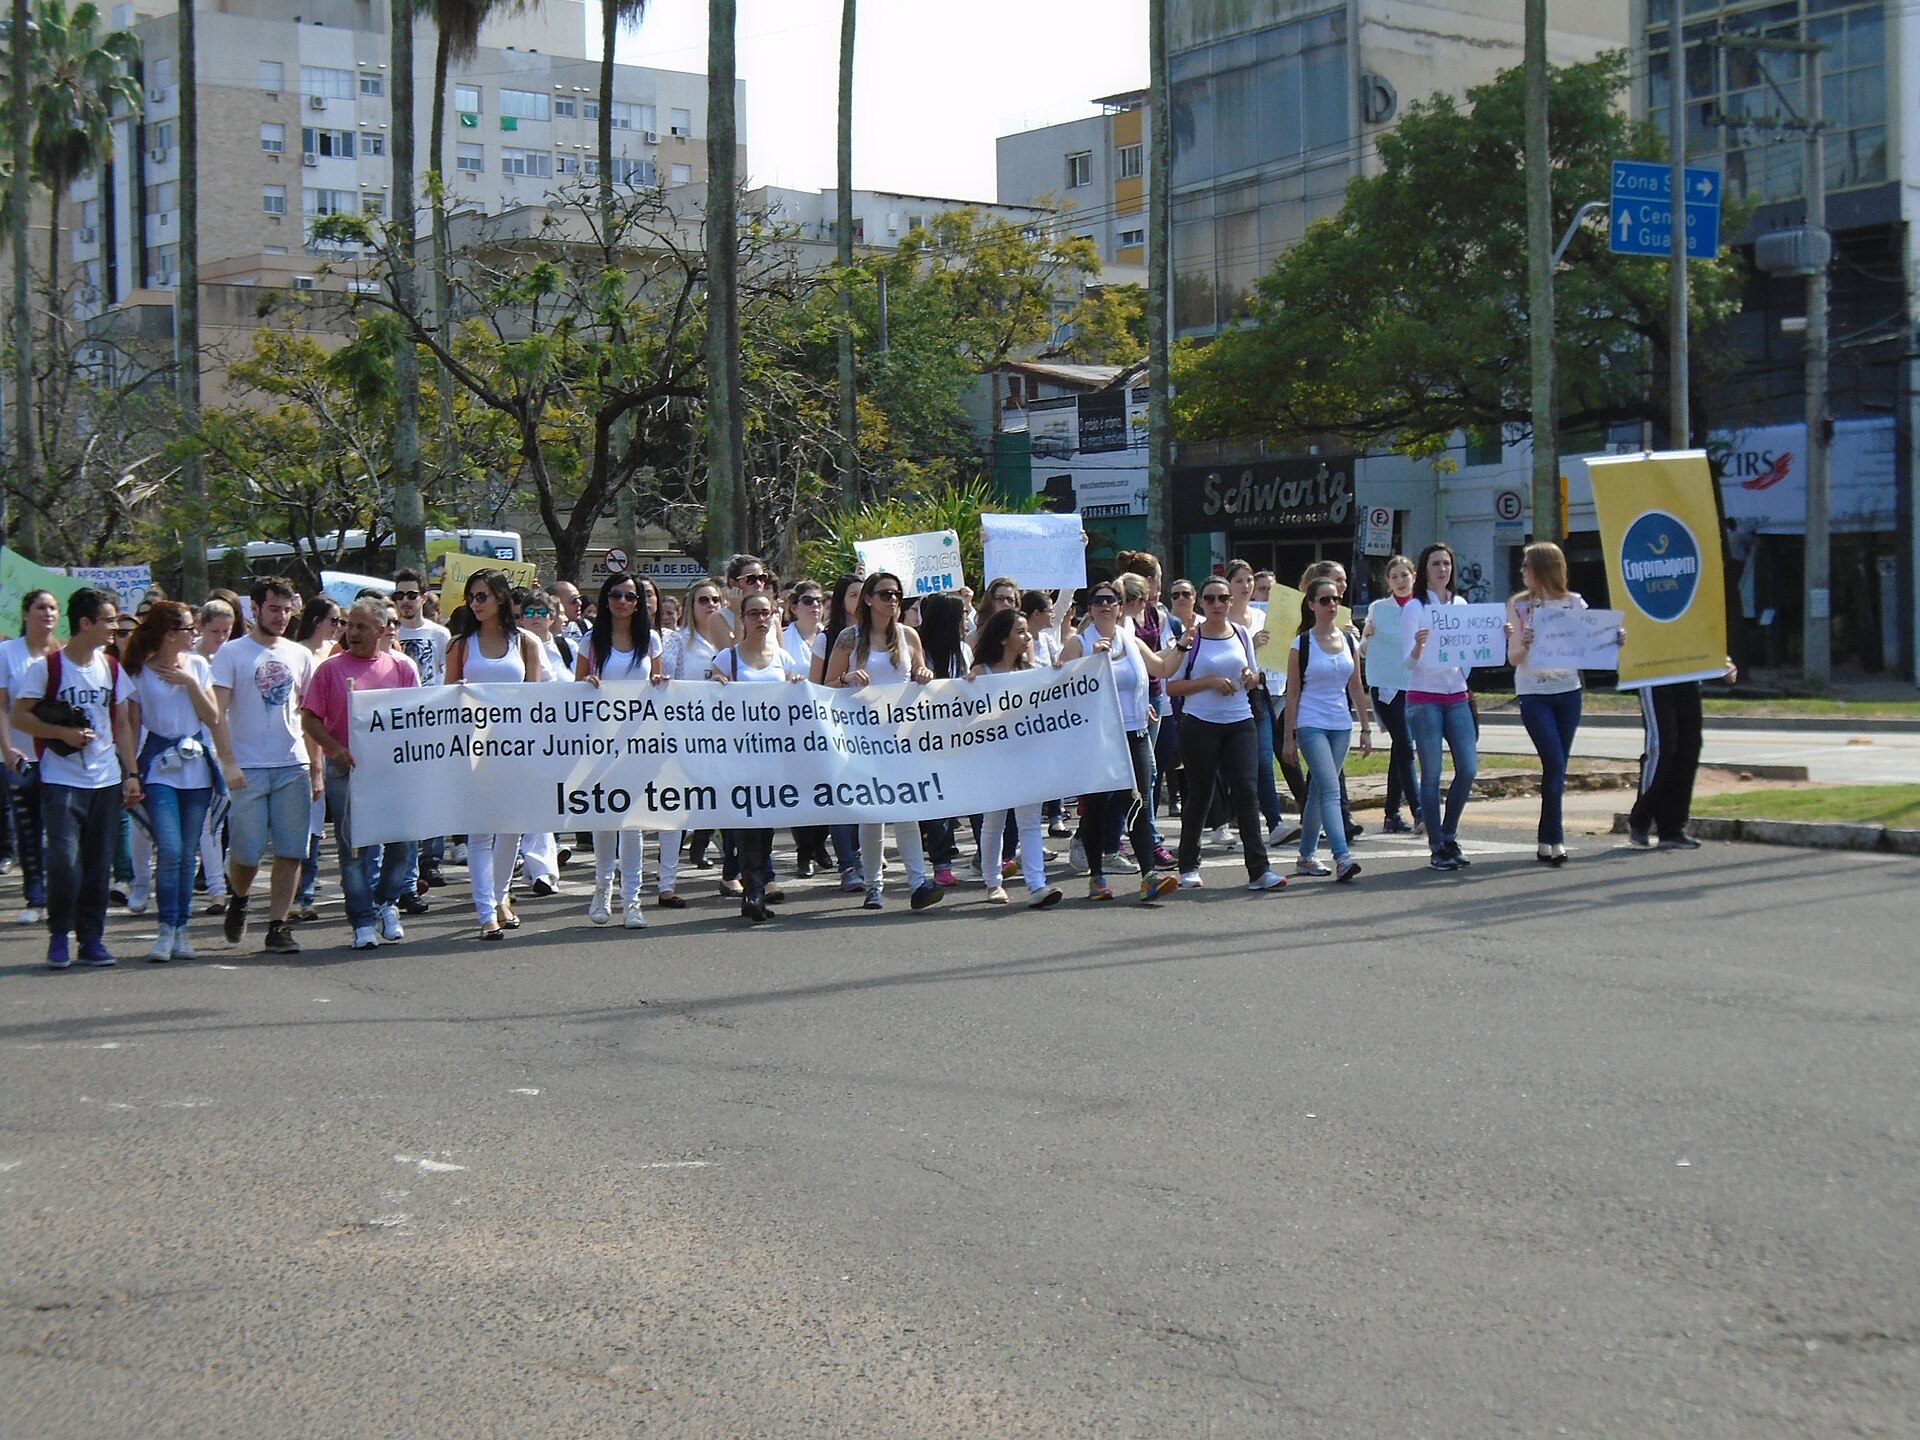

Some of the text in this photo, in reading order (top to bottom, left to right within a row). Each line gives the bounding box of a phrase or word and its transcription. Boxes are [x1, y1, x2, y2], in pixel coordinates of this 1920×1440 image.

[1615, 170, 1691, 193] Zona Sl
[1640, 205, 1696, 227] Ceno
[1639, 228, 1697, 249] Guaa
[1203, 462, 1353, 524] Schwartz
[1504, 498, 1514, 514] E
[77, 568, 140, 580] APRENDEMOS
[592, 564, 660, 574] ASLEIA
[664, 564, 678, 574] DE
[1623, 556, 1696, 582] Enfermagem
[1431, 610, 1503, 630] PELO NOSSO
[1440, 634, 1489, 647] DIREITO DE
[369, 674, 1100, 733] A Enfermagem da UFCSPA está de luto pela perda lastimável do querido
[392, 709, 1089, 764] aluno Alencar Junior, mais uma vítima da violência da nossa cidade.
[556, 772, 944, 817] Isto tem que acabar!
